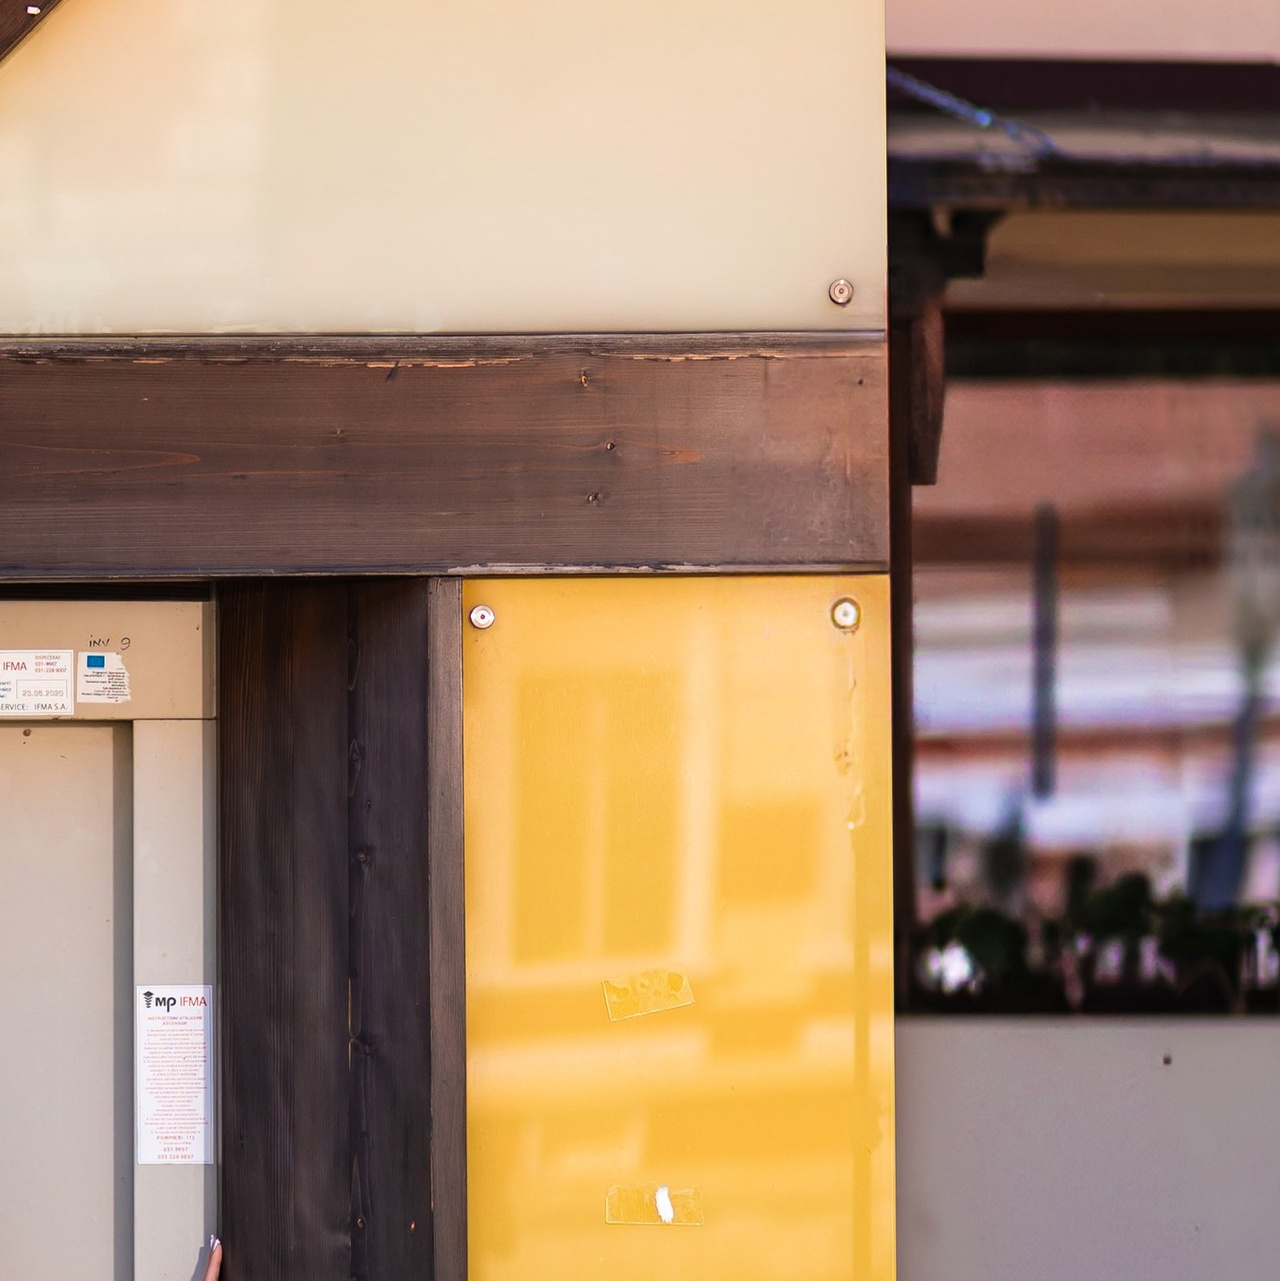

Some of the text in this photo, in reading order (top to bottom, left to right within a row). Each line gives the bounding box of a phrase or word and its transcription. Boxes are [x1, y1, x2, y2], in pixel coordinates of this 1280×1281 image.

[3, 662, 28, 671] IFMA
[34, 703, 53, 711] IFMA
[180, 996, 207, 1007] IFMA
